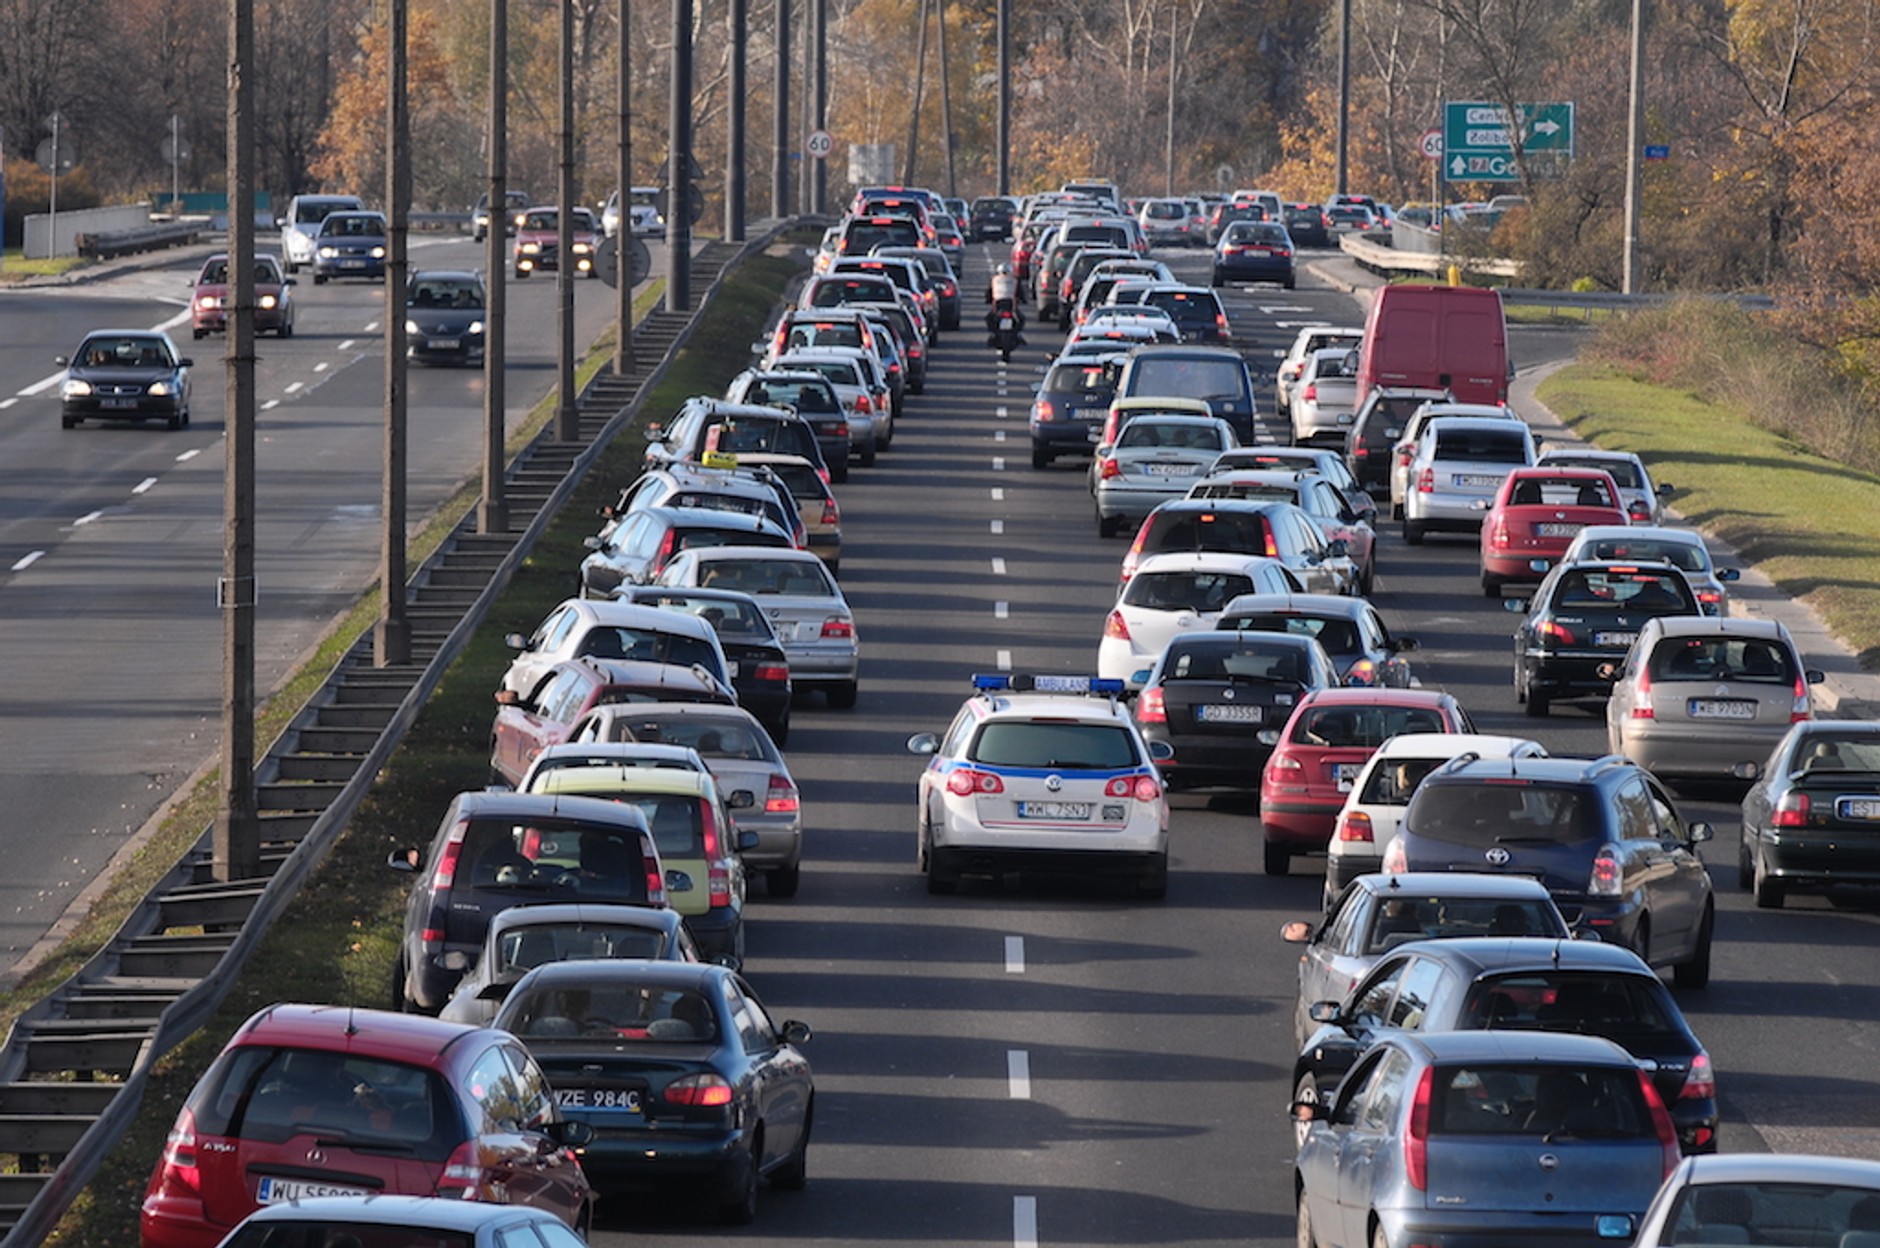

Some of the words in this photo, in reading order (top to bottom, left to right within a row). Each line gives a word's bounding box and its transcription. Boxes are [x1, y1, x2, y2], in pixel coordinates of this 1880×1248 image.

[810, 137, 830, 150] 60
[1036, 678, 1090, 691] AMBULANS
[1206, 704, 1222, 719] GD
[593, 1090, 639, 1107] 984C
[273, 1183, 299, 1202] WU
